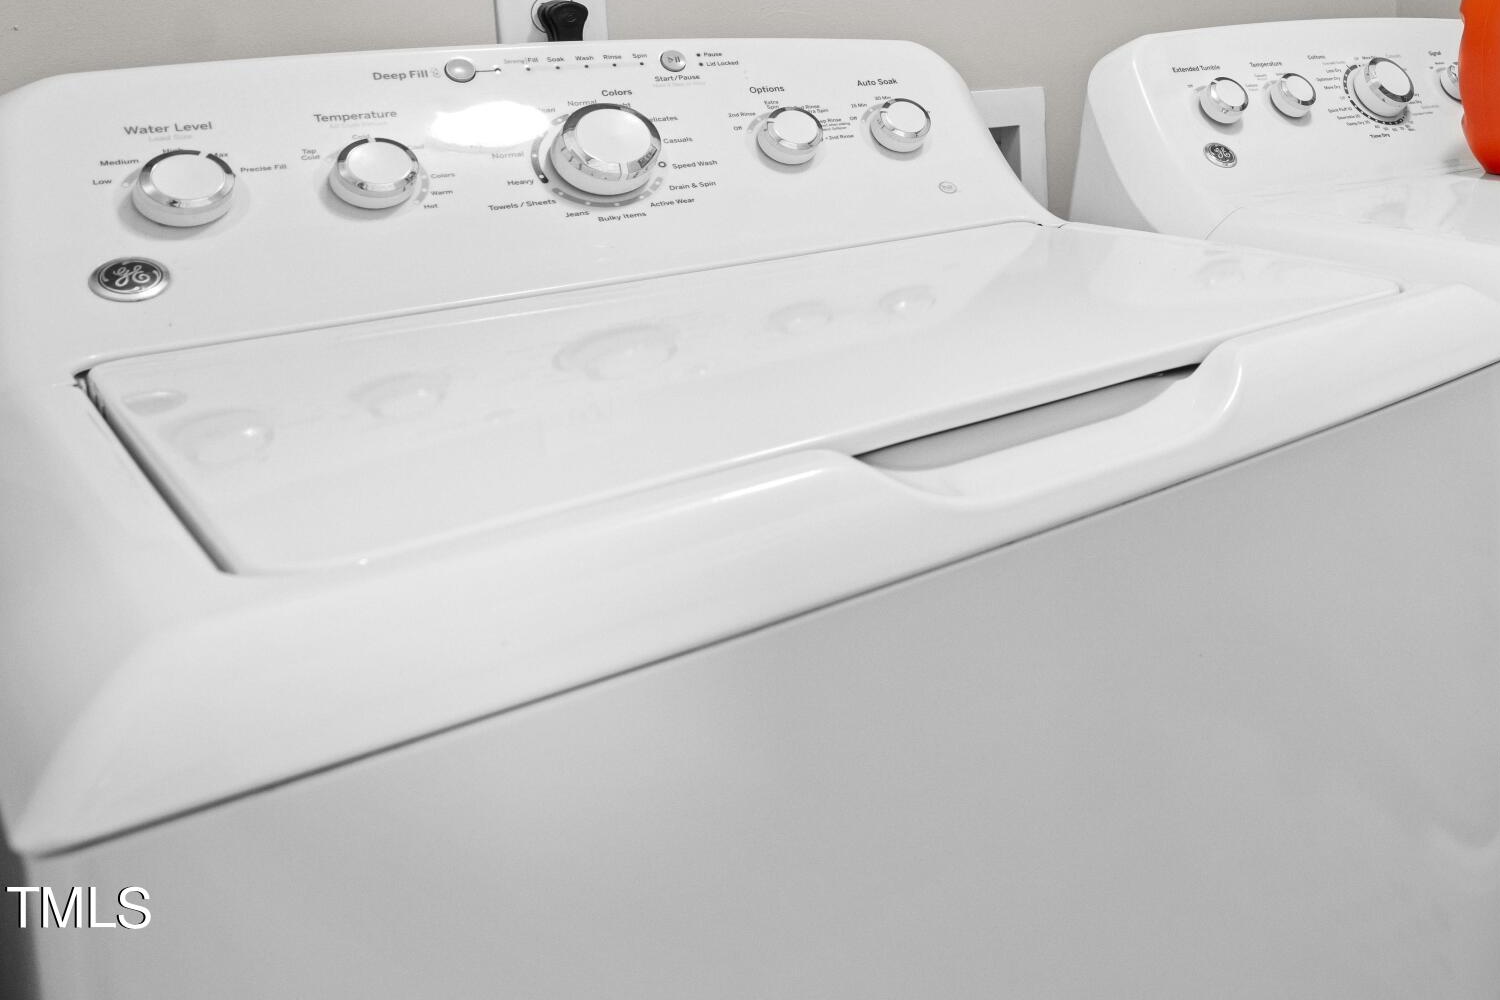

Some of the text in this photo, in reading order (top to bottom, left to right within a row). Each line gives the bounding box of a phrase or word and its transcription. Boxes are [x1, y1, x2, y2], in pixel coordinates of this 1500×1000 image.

[373, 69, 429, 81] Deep Fill
[857, 77, 898, 87] Auto Soak
[602, 88, 633, 97] Colors
[749, 85, 785, 94] Options
[314, 110, 398, 123] Temperature
[123, 120, 213, 136] Water Level
[662, 136, 694, 144] Casuals
[99, 157, 140, 167] Medium
[672, 159, 718, 170] Speed Wash
[240, 165, 272, 173] Precise
[430, 171, 456, 179] Colors
[92, 178, 113, 186] Low
[507, 178, 534, 187] Heavy
[669, 183, 691, 191] Drain
[698, 180, 717, 189] Spin
[488, 202, 520, 211] Towels
[525, 199, 557, 207] Sheets
[650, 197, 696, 208] Active Wear
[565, 209, 590, 218] Jeans
[597, 211, 647, 223] Bulky Items
